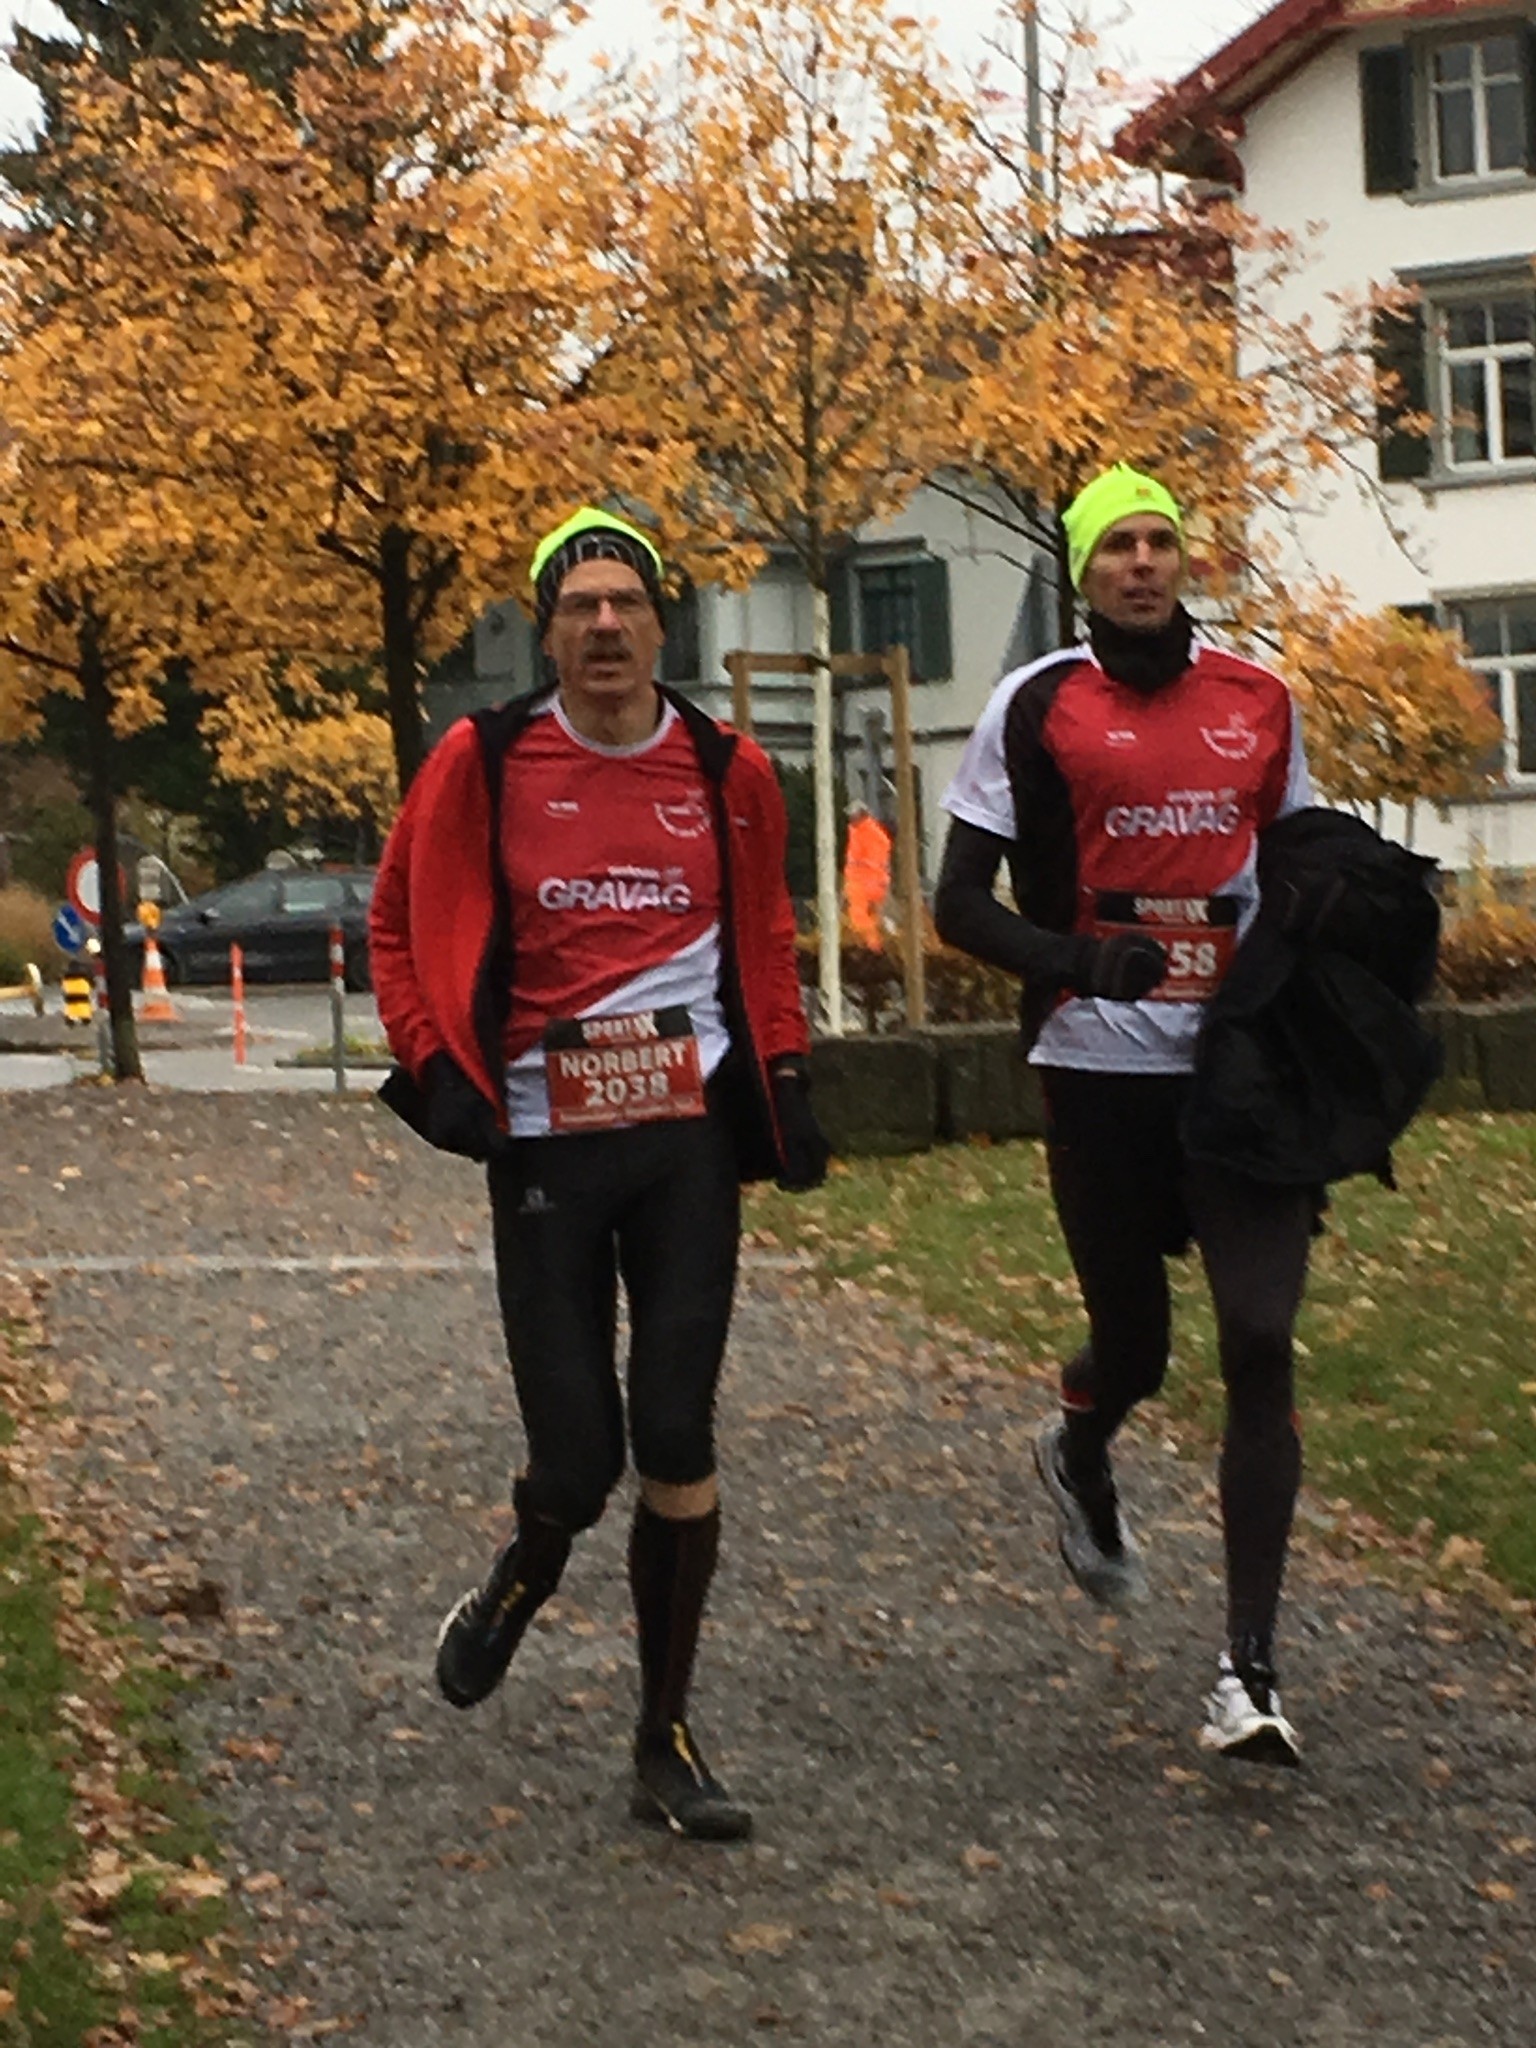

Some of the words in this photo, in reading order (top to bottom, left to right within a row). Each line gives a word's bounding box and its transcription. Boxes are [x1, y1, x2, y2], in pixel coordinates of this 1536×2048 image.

[1105, 805, 1239, 837] GRAVAG
[538, 878, 691, 913] GRAVAG
[1155, 940, 1217, 976] 58
[560, 1041, 686, 1078] NORBERT
[583, 1071, 669, 1107] 2038
